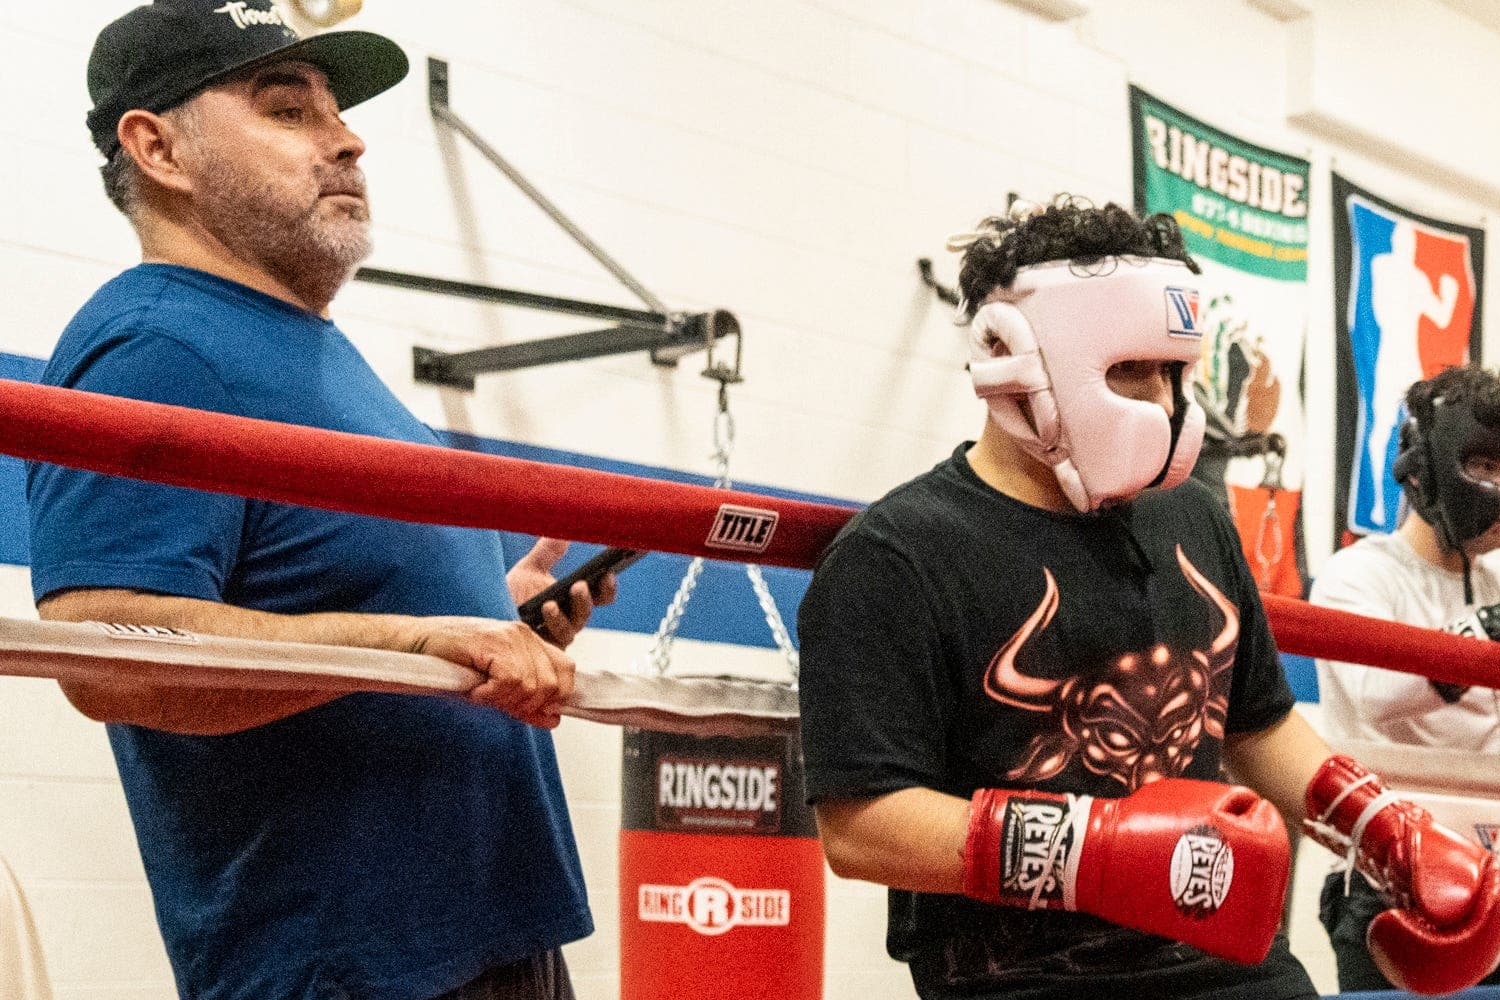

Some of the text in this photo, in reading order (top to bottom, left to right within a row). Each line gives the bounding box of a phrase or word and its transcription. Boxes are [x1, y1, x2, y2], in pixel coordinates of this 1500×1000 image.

[1146, 115, 1307, 219] RINGSIDE
[718, 513, 773, 544] TITLE
[659, 762, 777, 812] RINGSIDE
[1015, 803, 1063, 893] REYES
[1183, 834, 1222, 909] REYES
[643, 890, 683, 917] RING
[741, 895, 784, 920] SIDE
